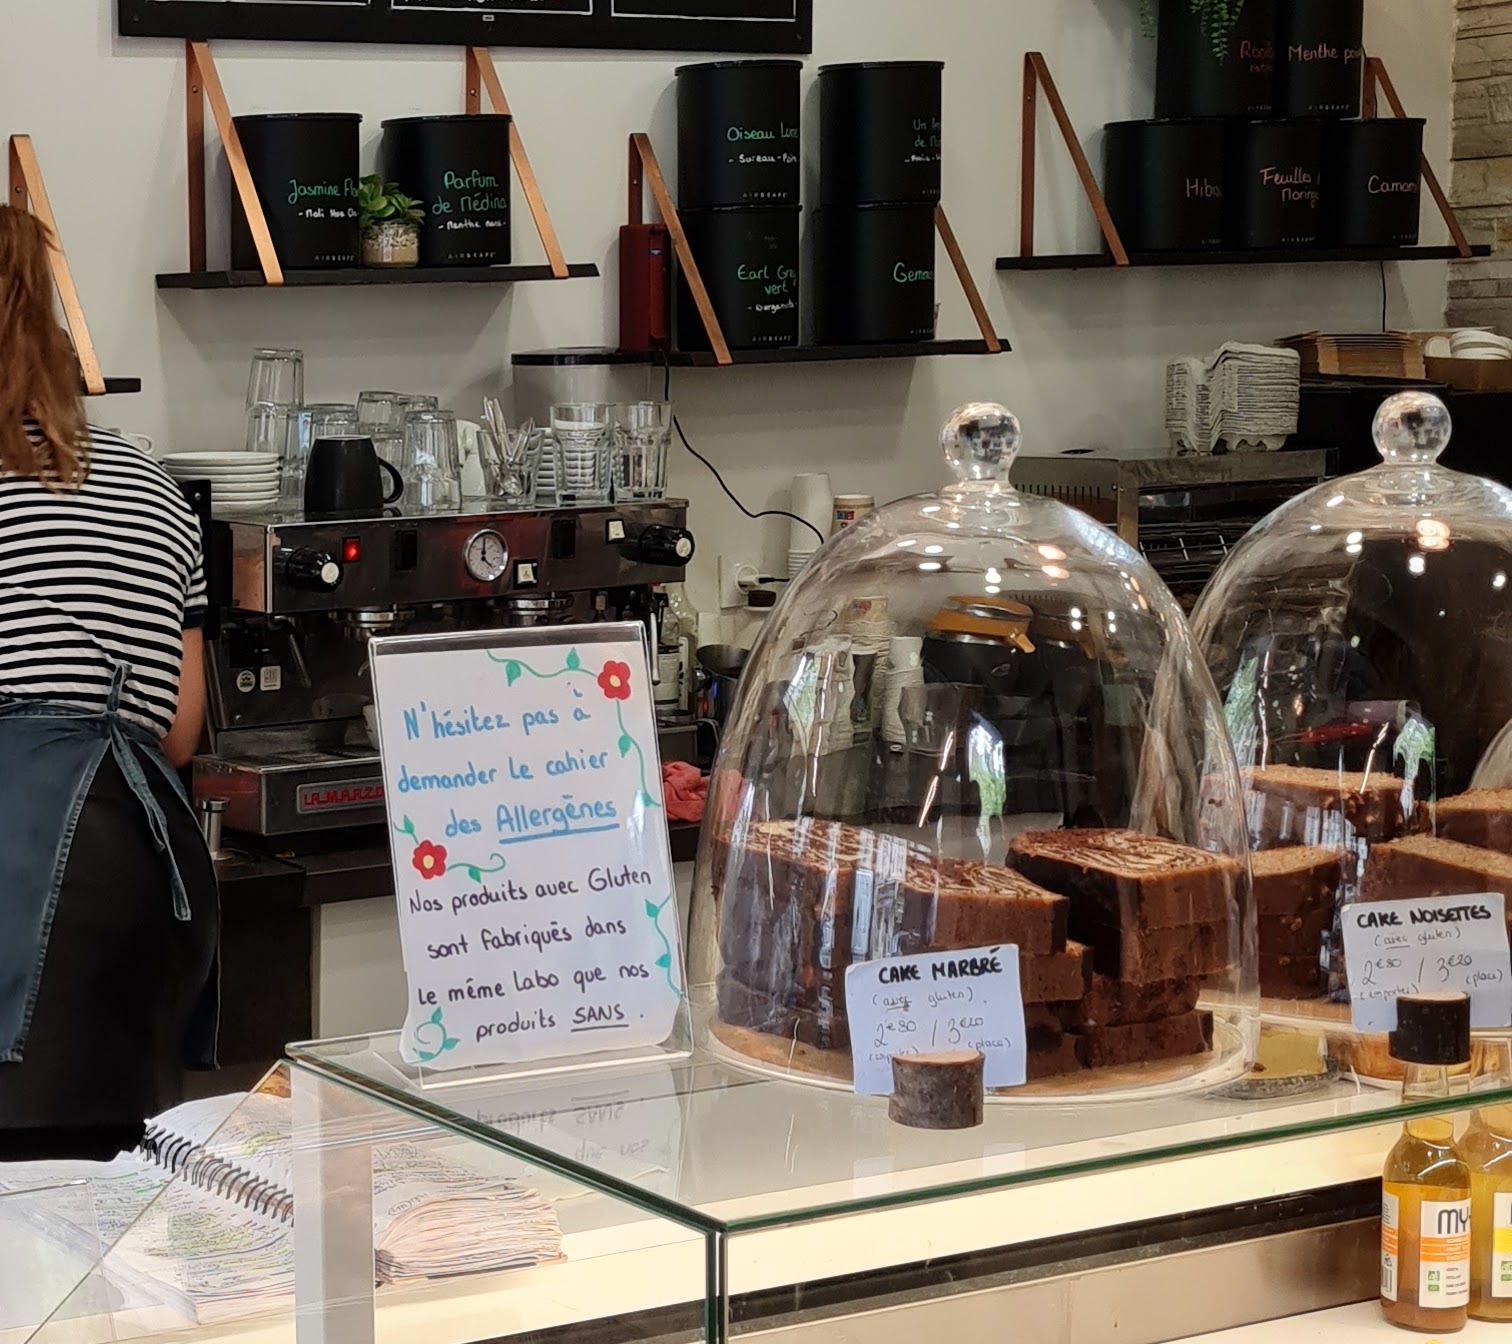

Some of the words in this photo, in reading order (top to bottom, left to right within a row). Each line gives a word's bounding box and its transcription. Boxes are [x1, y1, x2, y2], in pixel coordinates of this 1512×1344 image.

[1288, 42, 1339, 63] Menthe
[726, 126, 775, 142] Oiseau
[443, 169, 500, 190] Parfum
[1259, 166, 1312, 185] Feuilles
[287, 179, 341, 205] Jasmine
[431, 195, 453, 216] de
[737, 264, 769, 281] Earl
[763, 281, 789, 296] vert
[403, 701, 510, 740] N'hésitez
[523, 708, 559, 736] pas
[398, 765, 497, 793] demander
[510, 759, 534, 781] le
[546, 749, 608, 777] cahier
[445, 809, 482, 838] des
[497, 795, 617, 834] Allergènes
[409, 887, 443, 915] Nos
[452, 879, 528, 916] produits
[535, 878, 579, 898] avec
[588, 866, 653, 892] Gluten
[1357, 911, 1403, 928] CAKE
[1409, 904, 1492, 925] NOISETTES
[427, 932, 468, 960] sont
[481, 920, 572, 953] fabriqués
[585, 917, 627, 938] dans
[878, 964, 921, 984] CAKE
[932, 946, 1003, 981] MARBRÉ
[448, 976, 505, 1003] même
[573, 966, 607, 992] que
[619, 962, 650, 981] nos
[475, 1013, 556, 1044] produits
[571, 1003, 626, 1024] SANS
